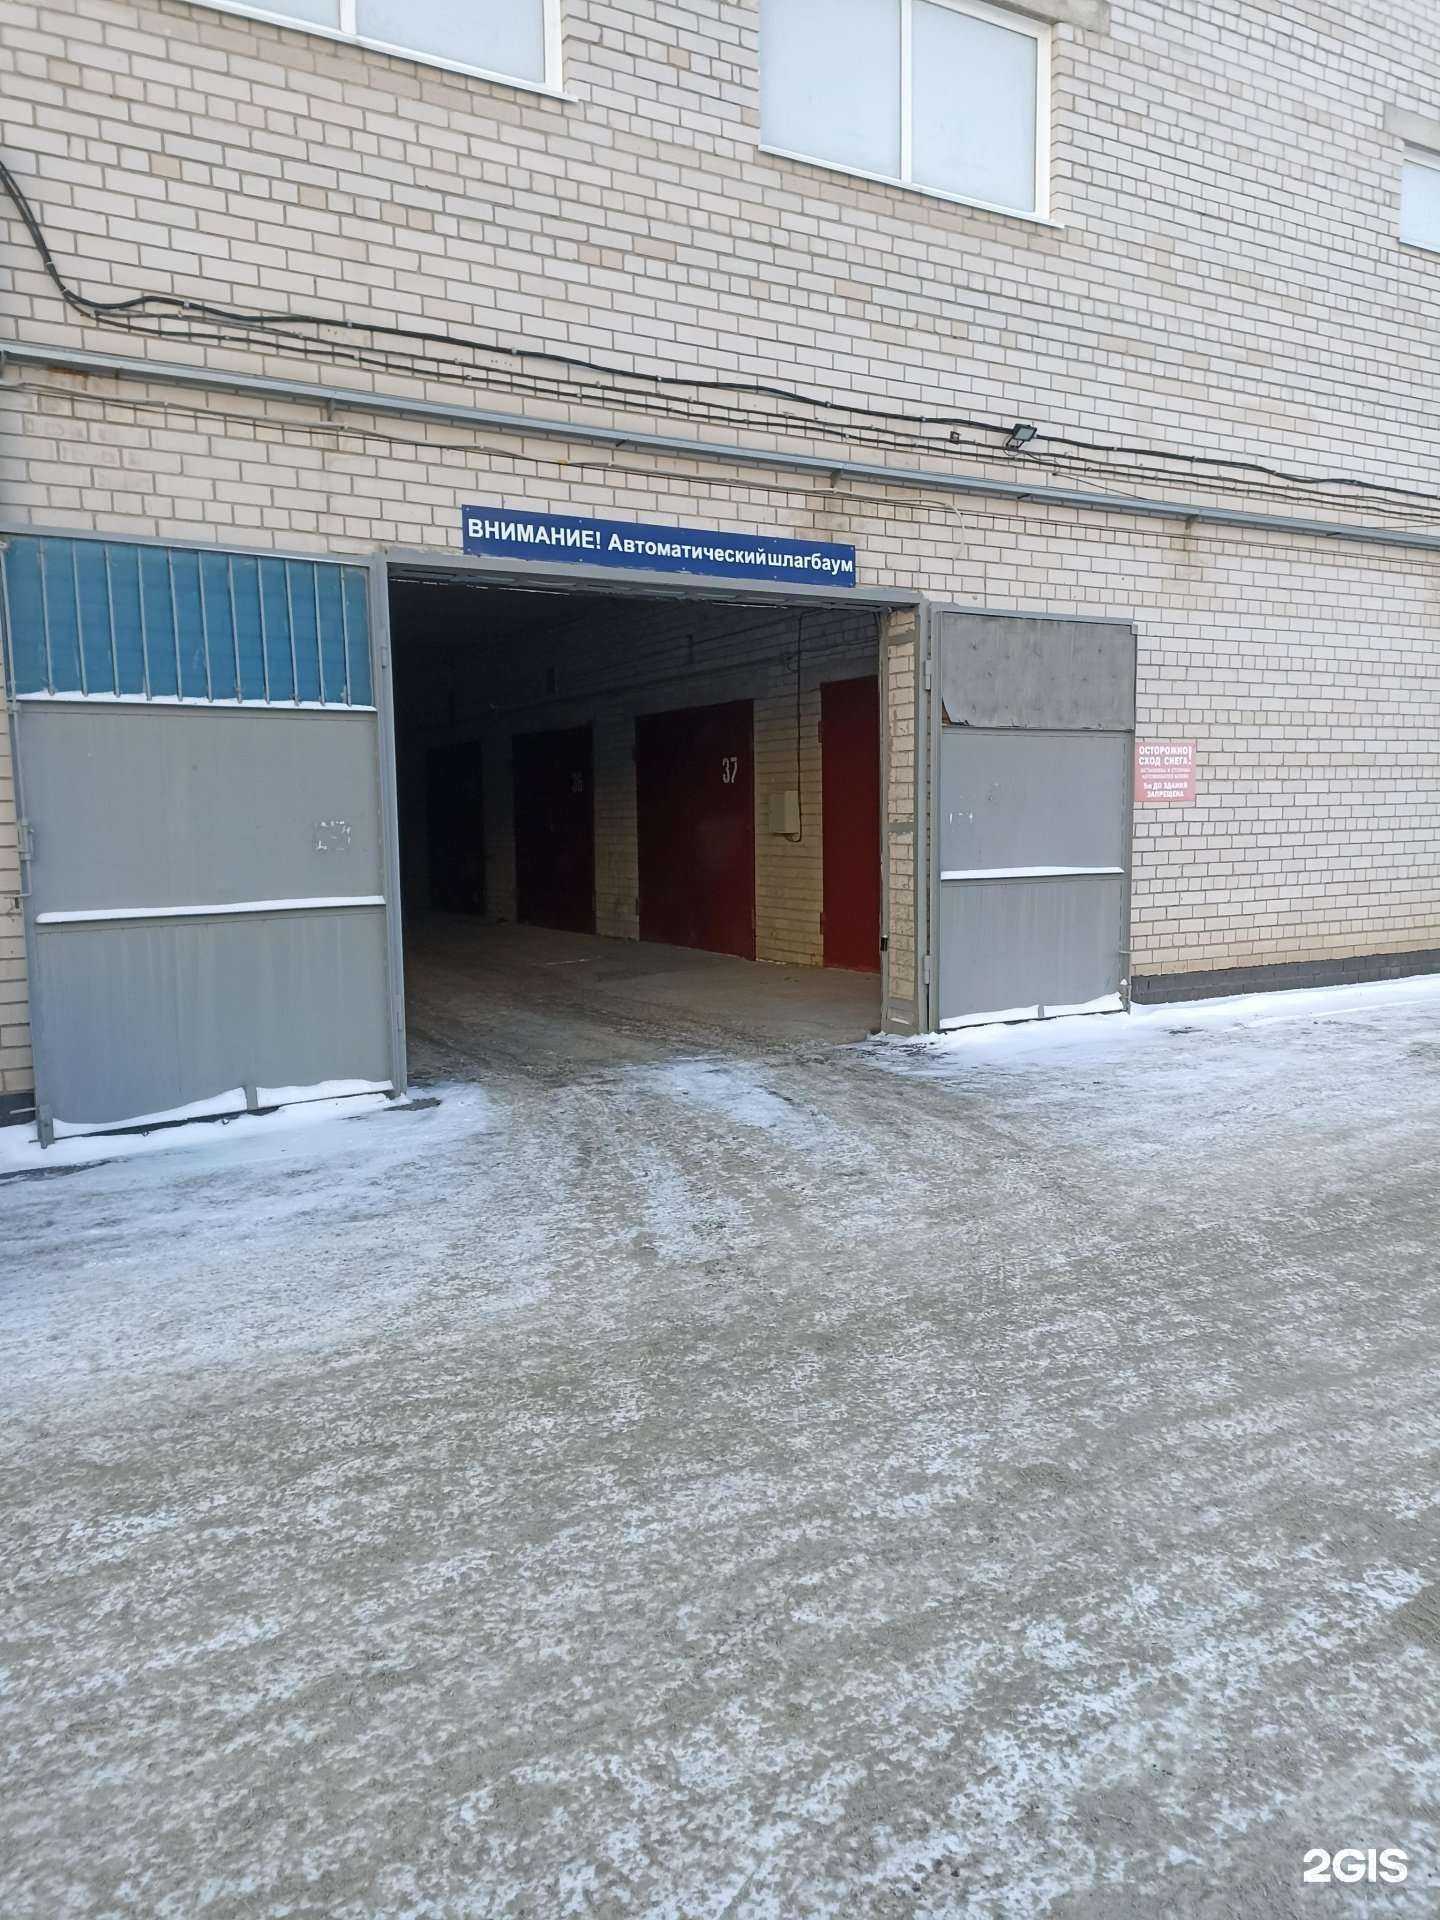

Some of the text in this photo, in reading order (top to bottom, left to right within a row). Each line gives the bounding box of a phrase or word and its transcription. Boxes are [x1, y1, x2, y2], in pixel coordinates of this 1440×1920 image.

[468, 518, 601, 550] ВНИМАНИЕ!
[722, 757, 738, 783] 37
[1138, 756, 1161, 767] СХОД
